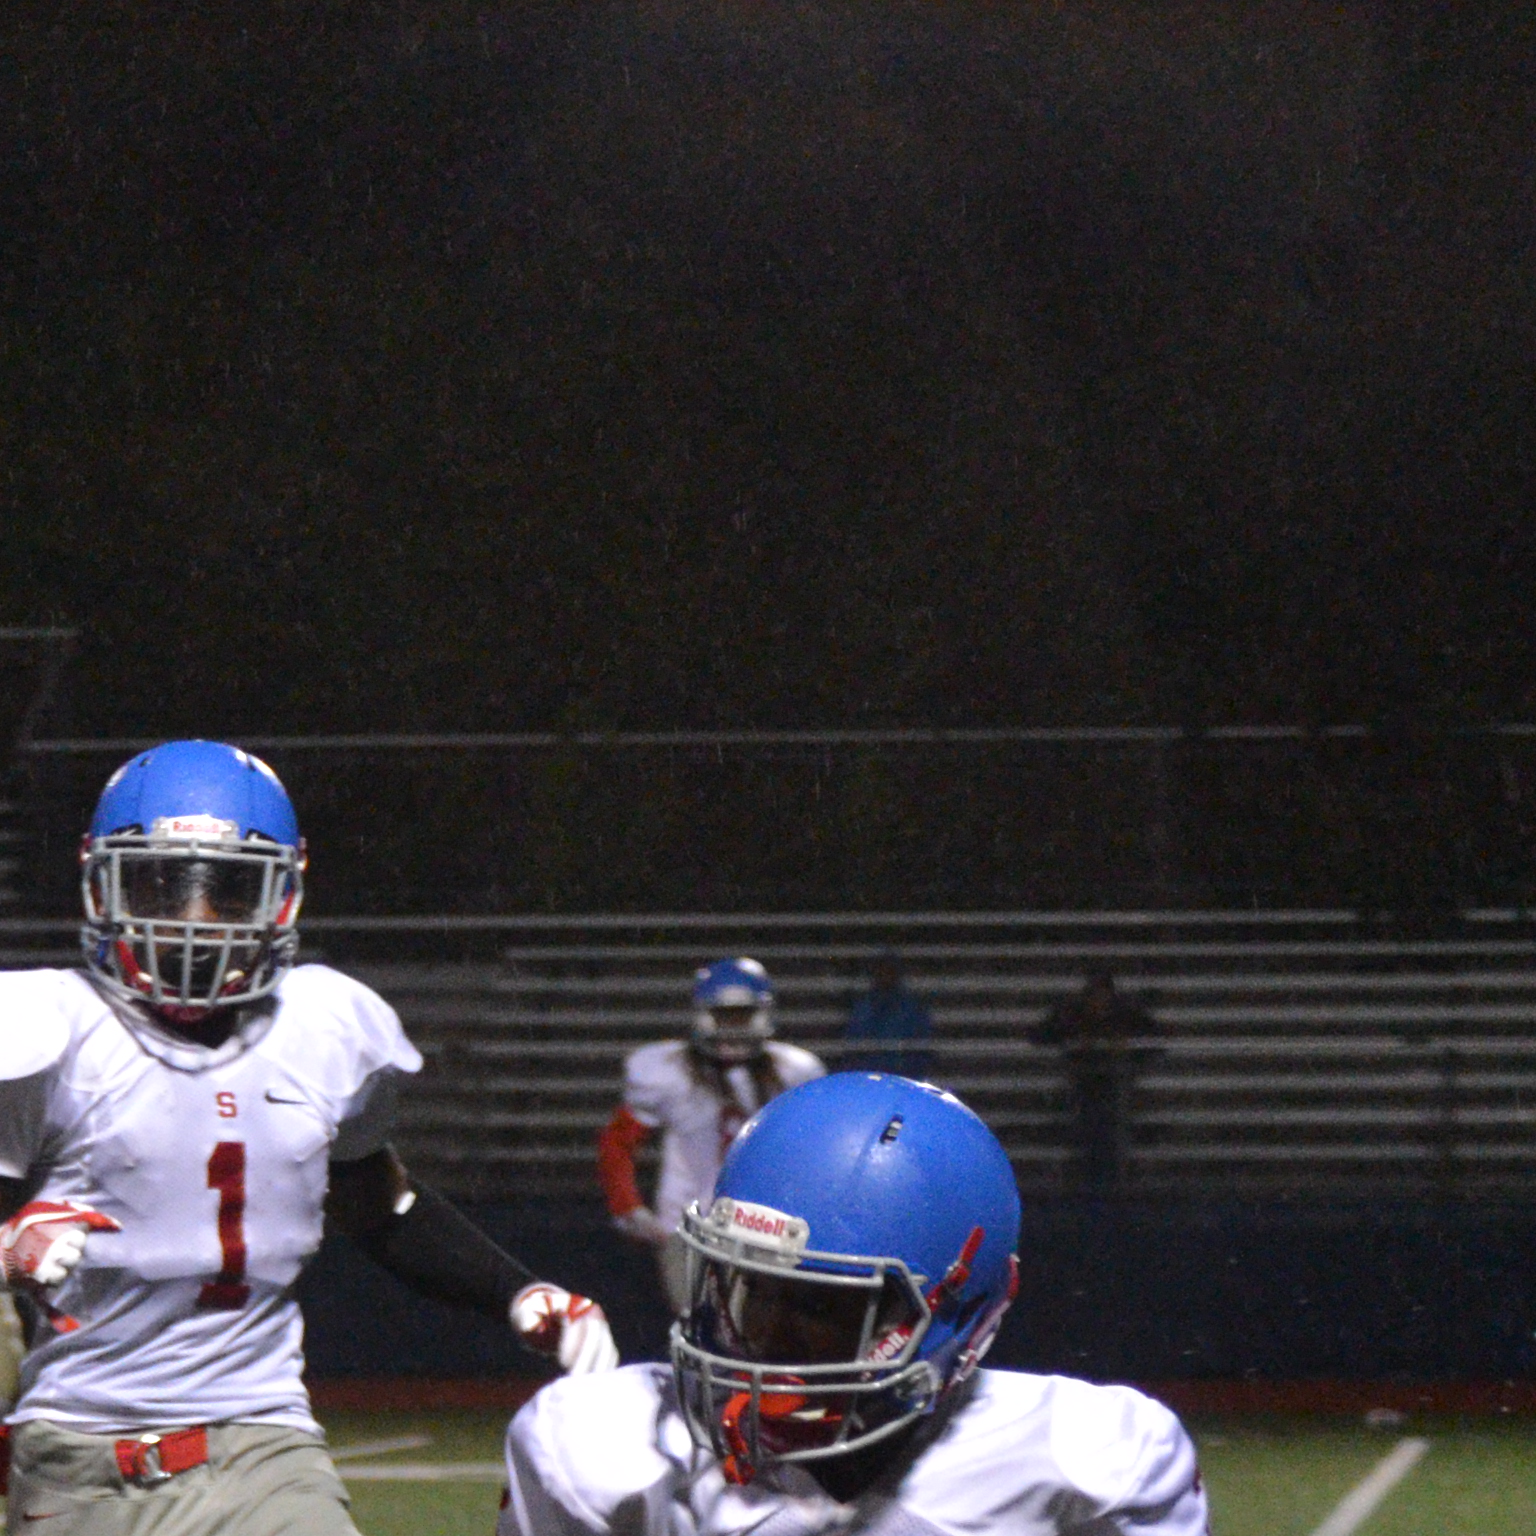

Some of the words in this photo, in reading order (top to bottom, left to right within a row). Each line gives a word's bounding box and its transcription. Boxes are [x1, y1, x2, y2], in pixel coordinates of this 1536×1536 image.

[216, 1091, 237, 1118] S
[194, 1141, 251, 1309] 1
[733, 1208, 787, 1235] Riddell
